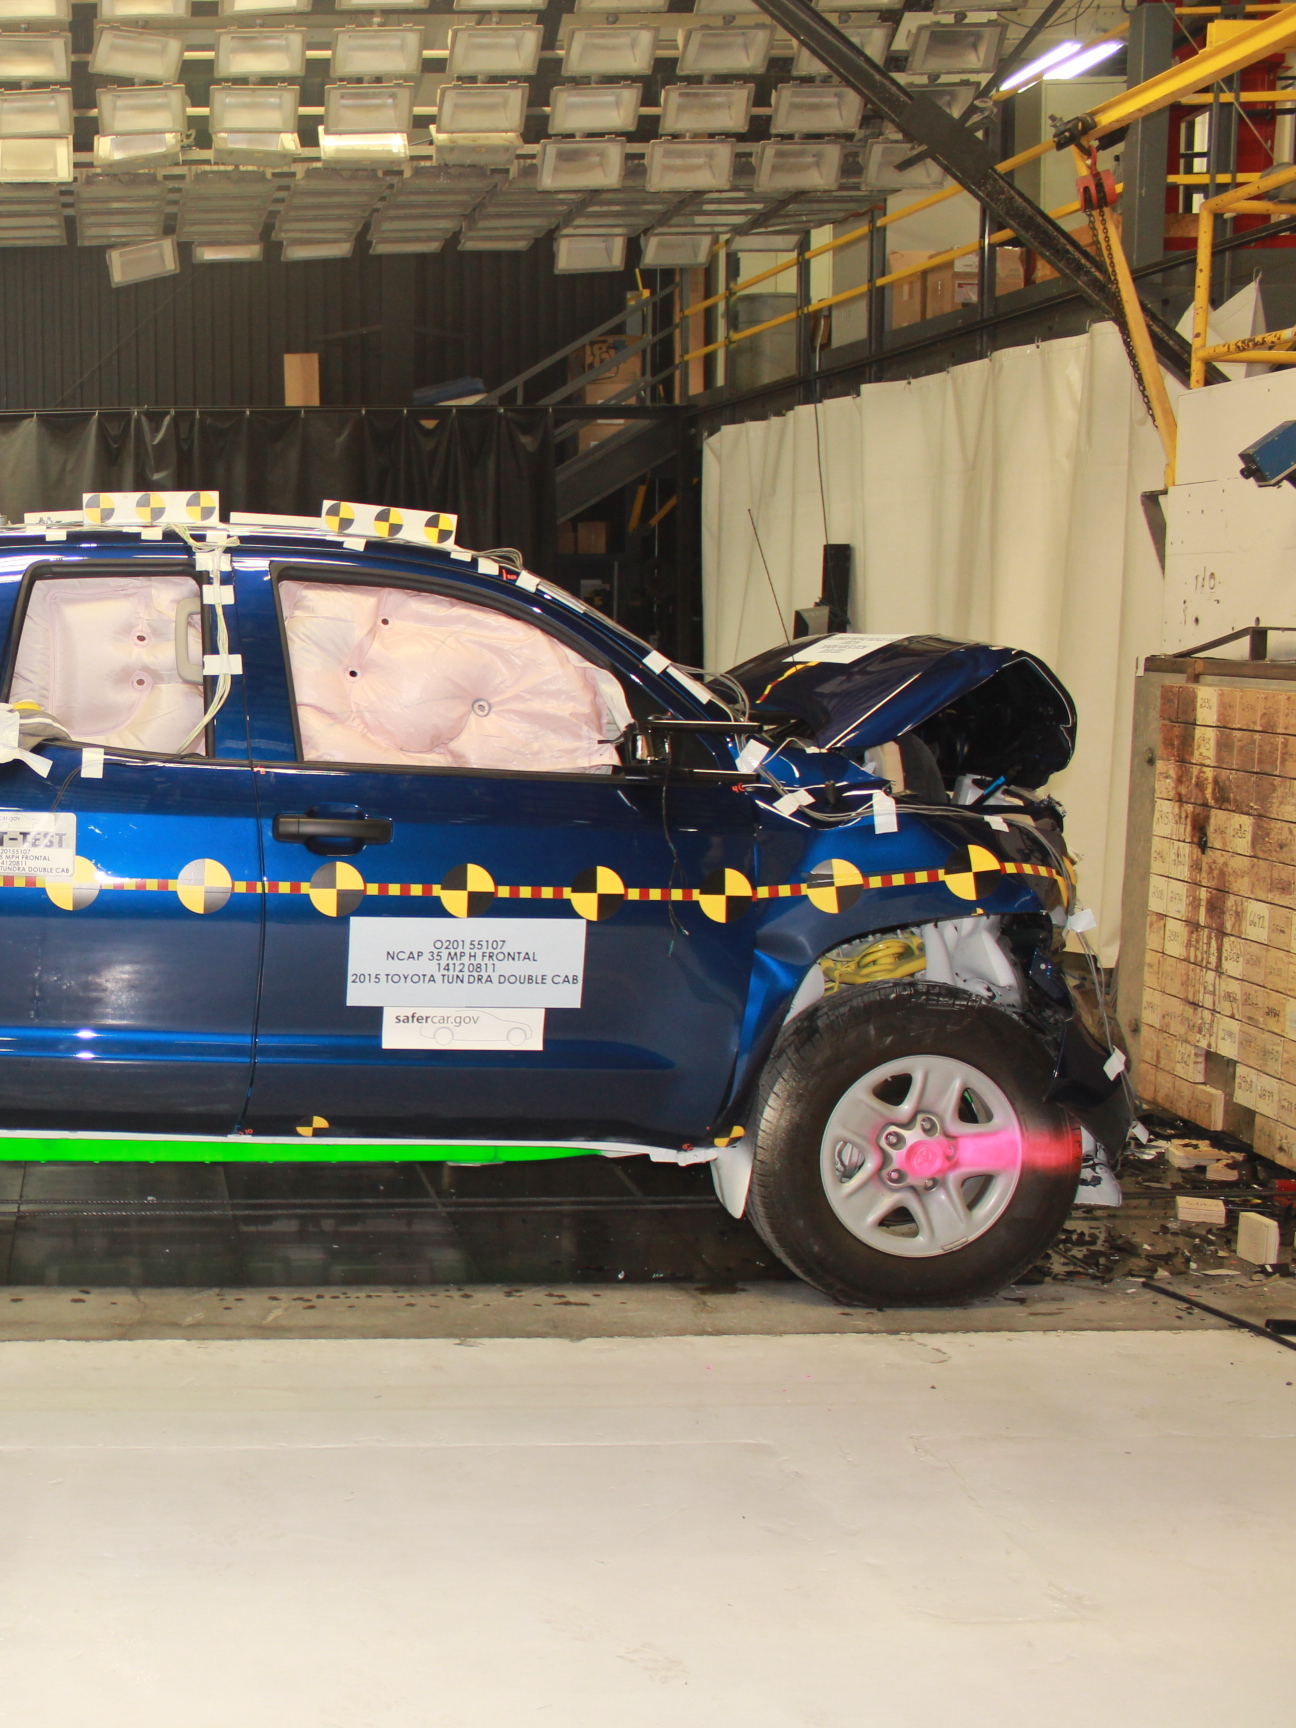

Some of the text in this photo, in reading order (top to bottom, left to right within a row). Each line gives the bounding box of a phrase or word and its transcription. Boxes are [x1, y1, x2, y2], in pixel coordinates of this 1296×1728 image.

[386, 950, 538, 962] NCAP 35 MPH FRONTAL
[436, 962, 497, 973] 14120811
[351, 973, 579, 985] 2015 TOYOTA TUNDRA DOUBLE CAB
[395, 1012, 480, 1027] safercar.gov
